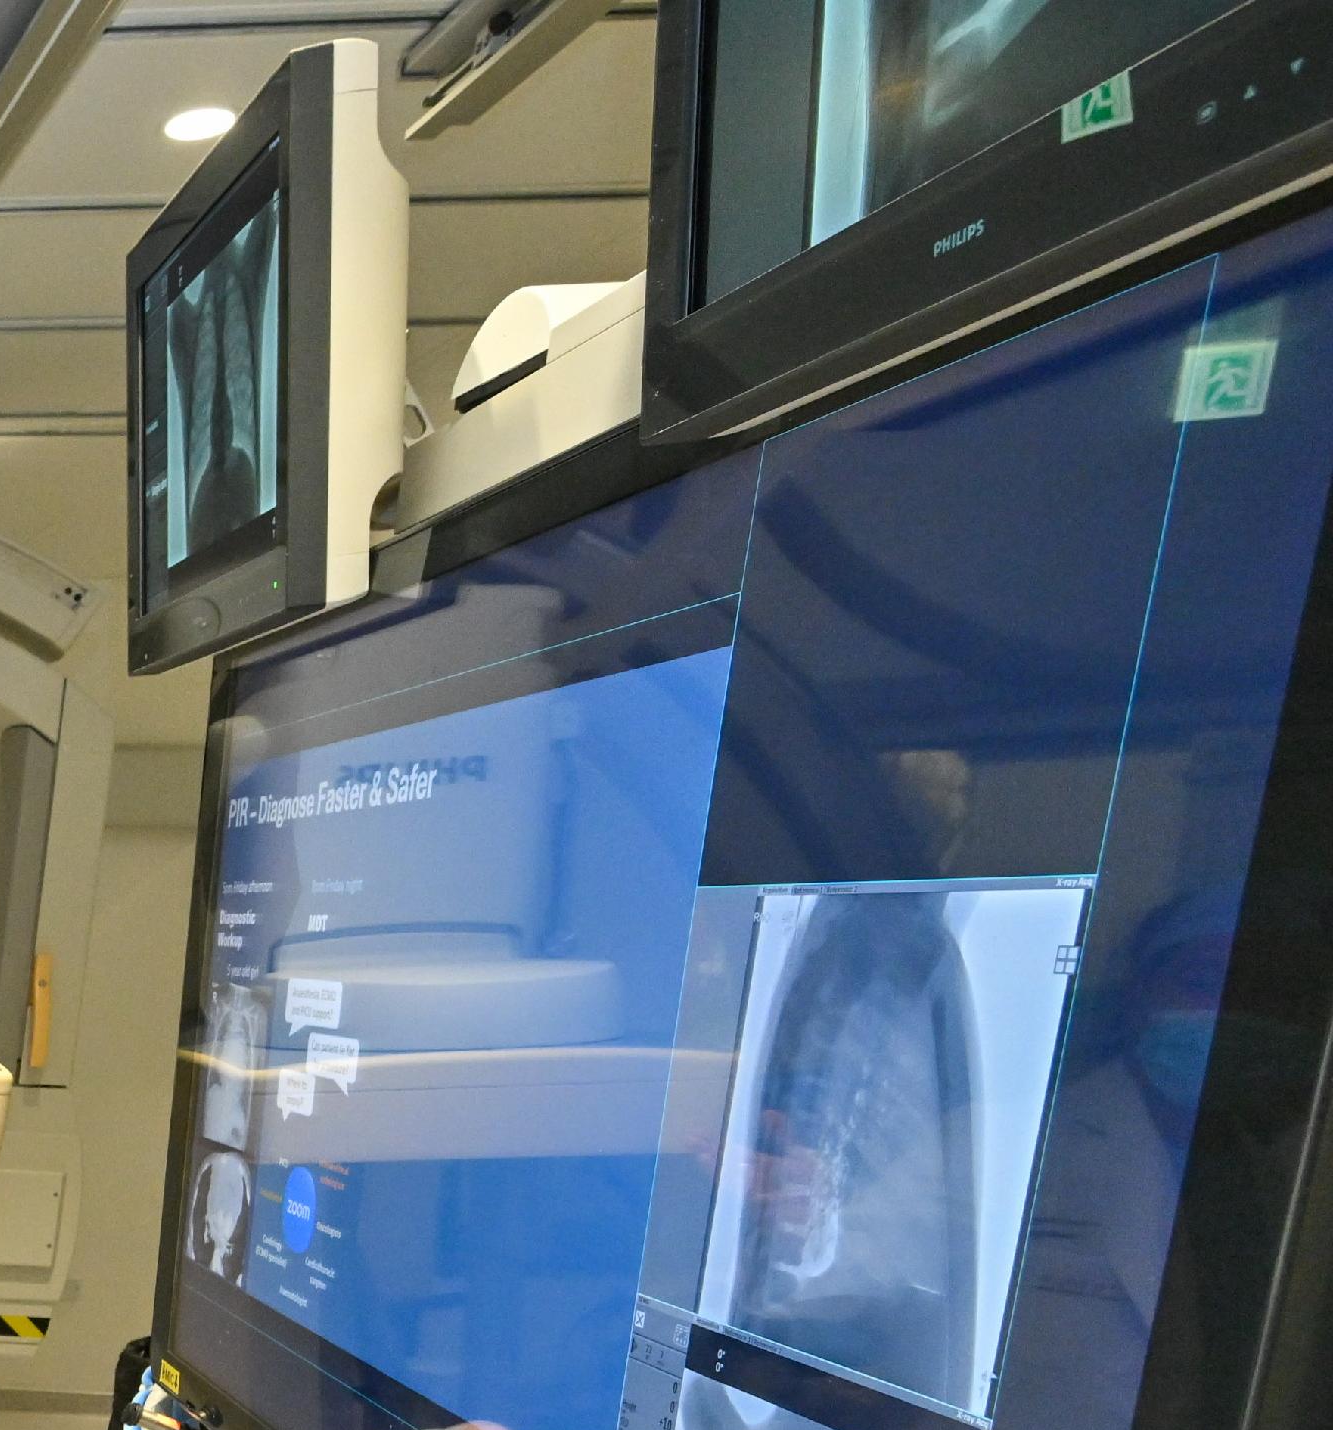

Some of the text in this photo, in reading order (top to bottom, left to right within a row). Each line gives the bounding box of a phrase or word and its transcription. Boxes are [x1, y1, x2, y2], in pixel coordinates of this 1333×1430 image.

[934, 218, 985, 258] PHILIPS
[227, 796, 250, 828] PIR
[257, 792, 315, 829] Diagnose
[316, 780, 369, 816] Faster
[369, 771, 383, 807] &
[386, 763, 438, 805] Safer
[219, 909, 257, 928] Diagnostic
[217, 932, 243, 950] Workup
[286, 1199, 312, 1222] zoom
[673, 1382, 678, 1394] 0
[669, 1401, 675, 1413] 0
